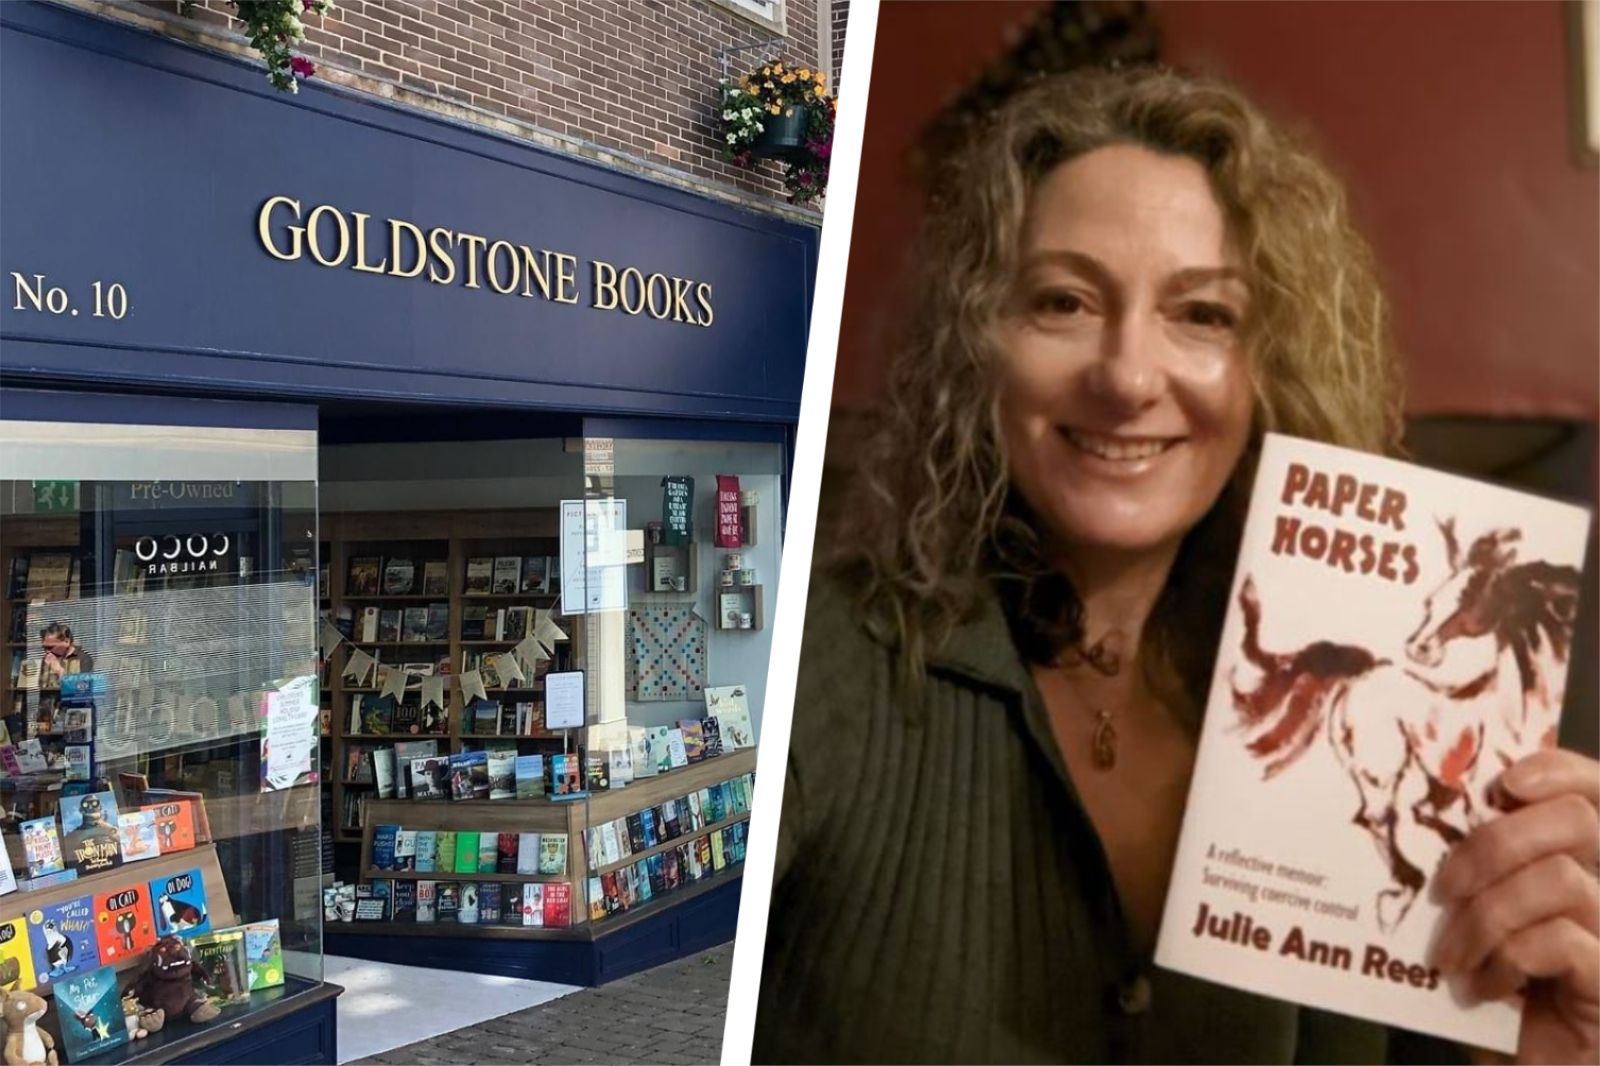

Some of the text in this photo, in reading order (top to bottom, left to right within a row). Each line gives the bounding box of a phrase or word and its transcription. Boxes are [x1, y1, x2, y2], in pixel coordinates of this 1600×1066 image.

[258, 196, 714, 327] GOLDSTONE BOOKS
[10, 271, 128, 319] No. 10
[130, 481, 234, 500] Pre-Owned
[1281, 463, 1407, 532] PAPER
[1271, 515, 1420, 586] HORSES
[1206, 843, 1216, 859] A
[1218, 848, 1274, 875] reflective
[1202, 865, 1360, 921] Surviving coercive control
[1193, 901, 1442, 991] Julie Ann Rees
